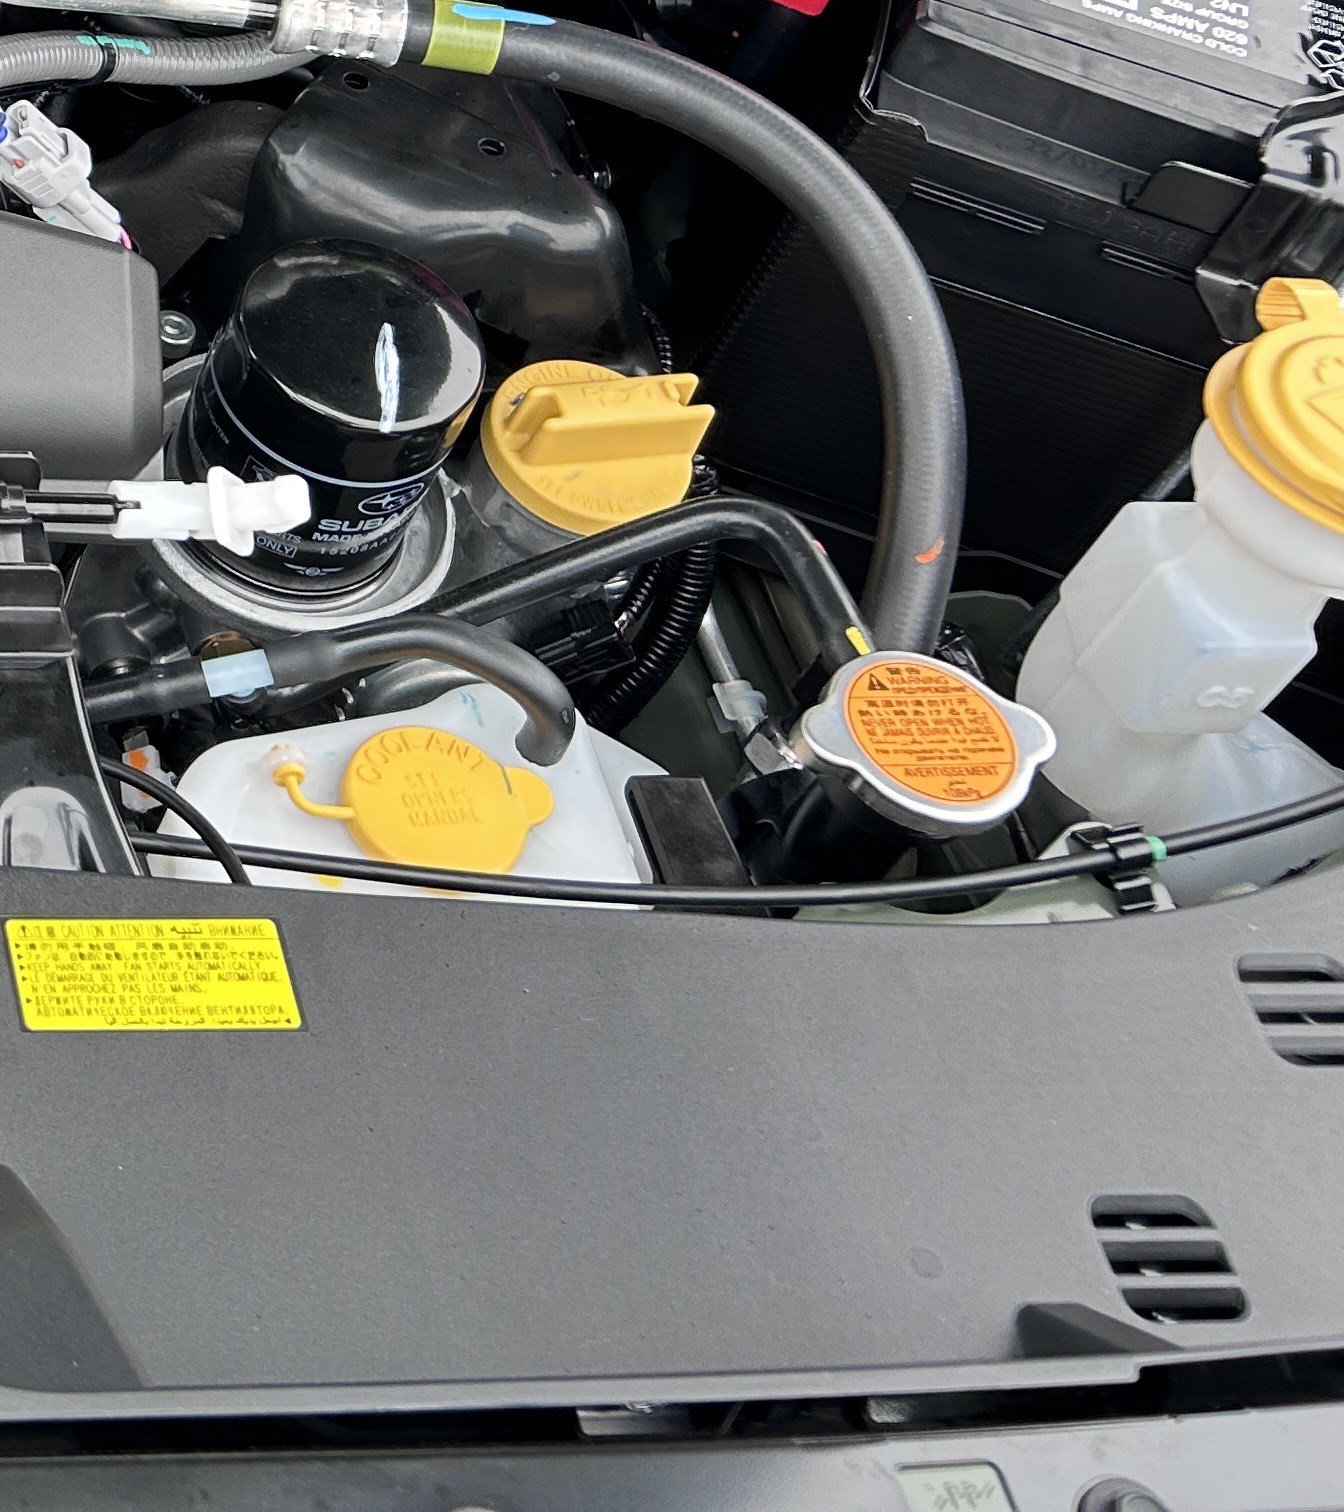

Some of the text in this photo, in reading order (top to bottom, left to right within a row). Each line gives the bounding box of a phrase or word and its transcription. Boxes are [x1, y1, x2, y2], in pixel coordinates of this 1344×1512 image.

[1148, 5, 1209, 34] AMPS
[257, 537, 296, 556] ONLY
[887, 676, 949, 686] WARNING
[357, 731, 484, 784] COOLANT
[904, 766, 998, 777] AVERTISSEMENT
[61, 925, 164, 937] CAUTION ATTENTION
[208, 924, 266, 936] ВНИМАНИЕ
[124, 962, 141, 971] FAN
[146, 962, 181, 971] STARTS
[118, 973, 178, 982] VENTILATEUR
[62, 984, 117, 993] APPROCHEZ
[122, 984, 141, 993] PAS
[146, 984, 165, 993] LES
